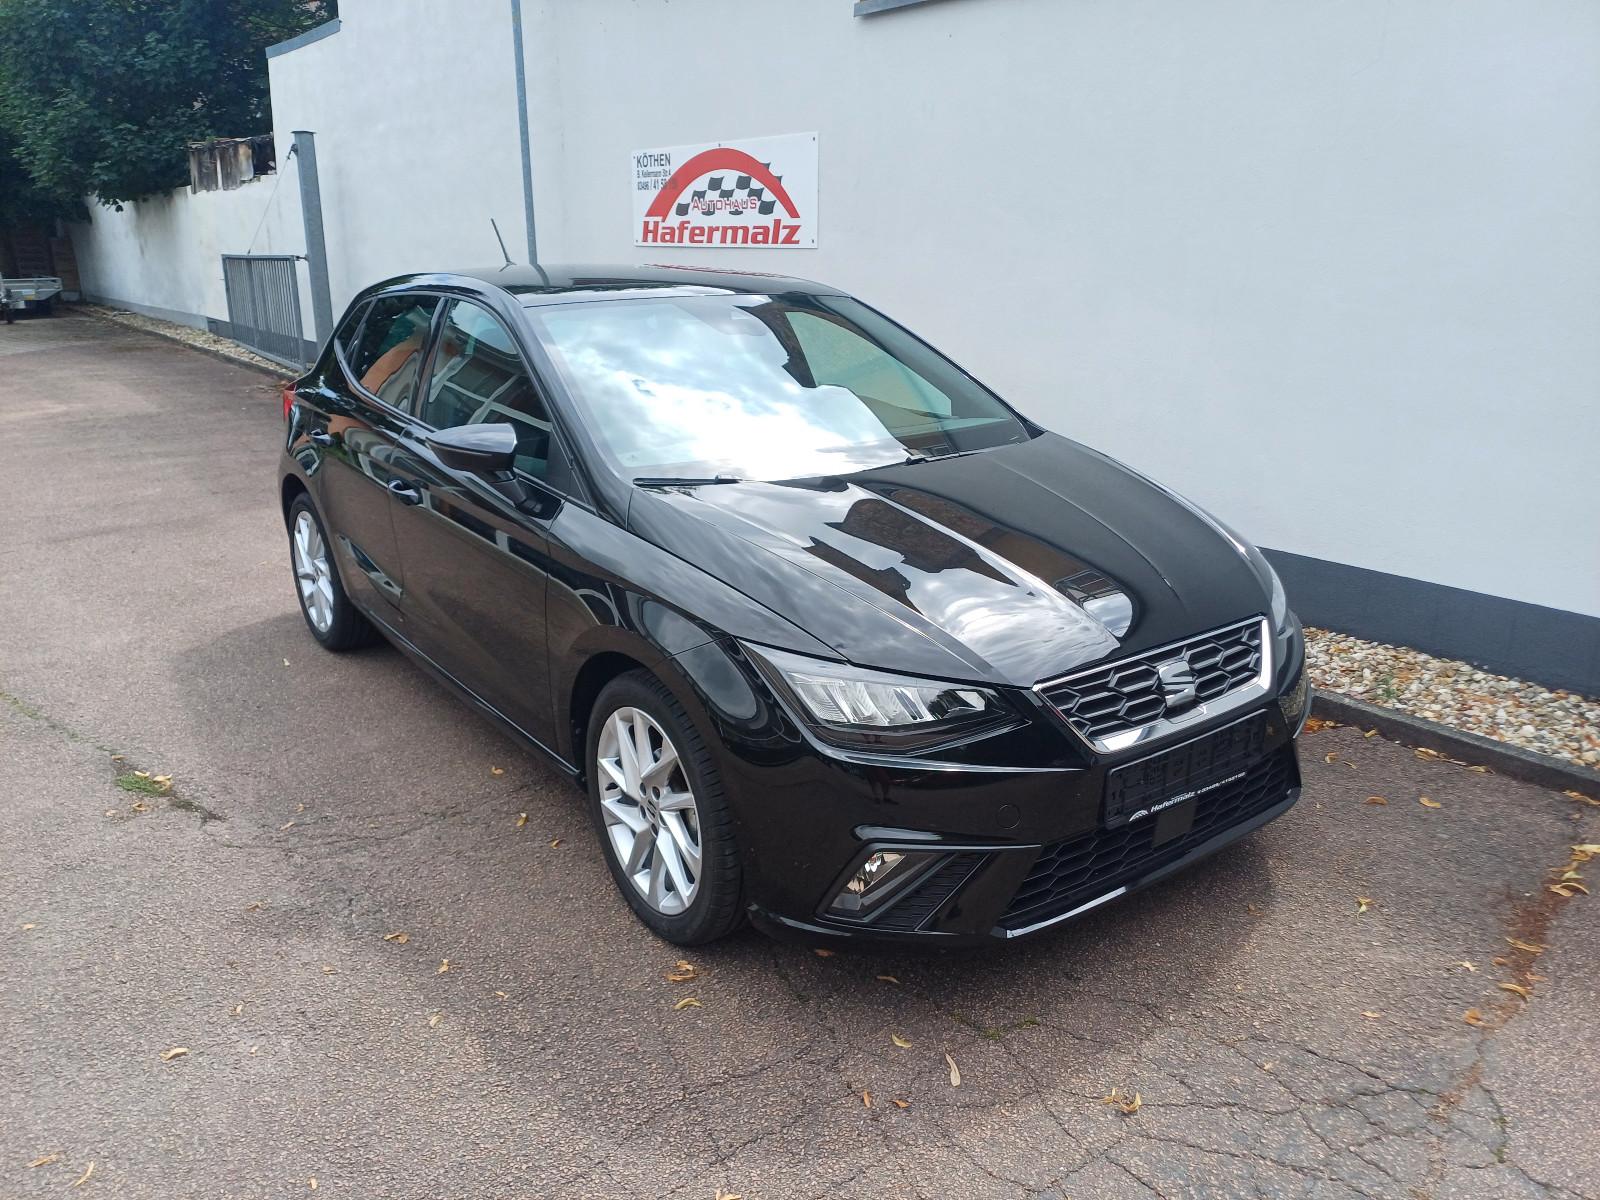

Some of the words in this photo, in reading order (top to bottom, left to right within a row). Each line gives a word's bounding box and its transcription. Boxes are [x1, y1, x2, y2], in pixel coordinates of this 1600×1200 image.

[637, 153, 671, 168] KÖTHEN
[692, 196, 758, 211] AUTOHAUS
[641, 218, 801, 244] Hafermalz
[1150, 791, 1196, 813] Hafermalz
